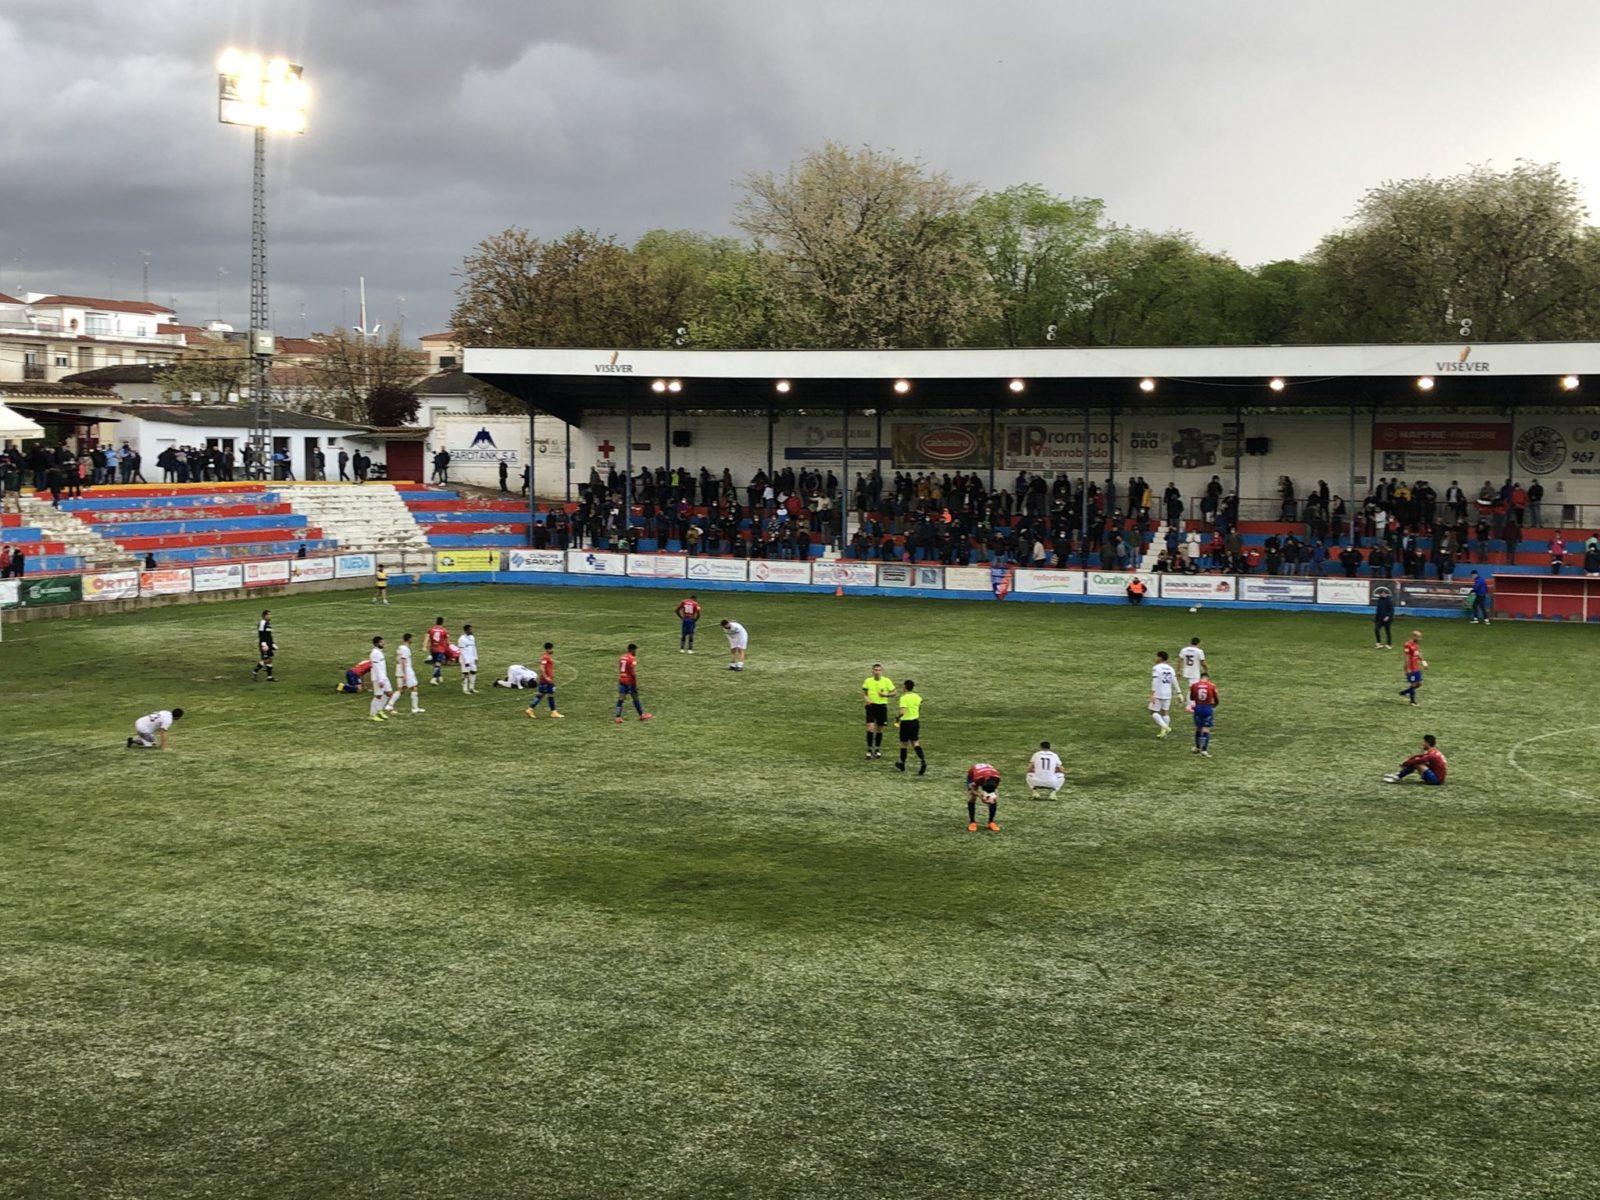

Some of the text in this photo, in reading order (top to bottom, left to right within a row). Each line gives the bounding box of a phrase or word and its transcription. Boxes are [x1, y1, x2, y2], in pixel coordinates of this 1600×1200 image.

[595, 364, 633, 373] VISEVER
[1436, 361, 1490, 372] VISEVER
[1023, 426, 1119, 456] Promnox
[1131, 439, 1158, 449] ORO
[1571, 451, 1595, 463] 967
[1040, 757, 1051, 770] 11
